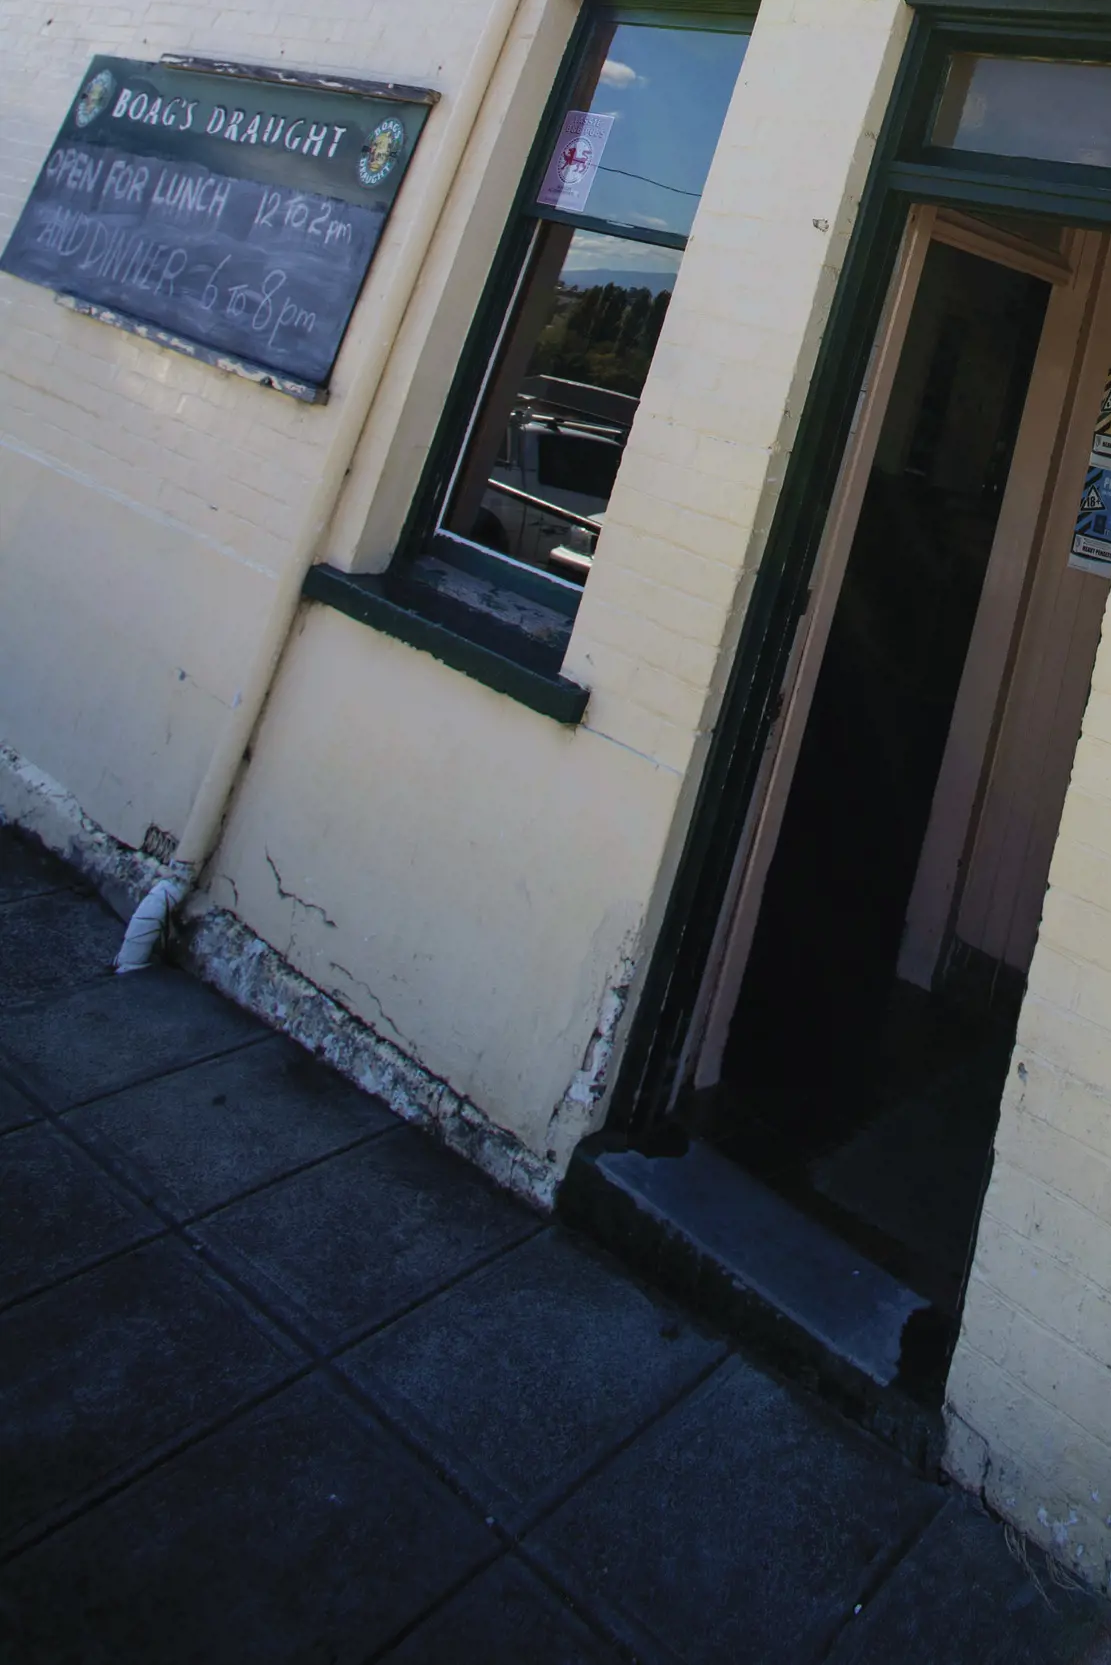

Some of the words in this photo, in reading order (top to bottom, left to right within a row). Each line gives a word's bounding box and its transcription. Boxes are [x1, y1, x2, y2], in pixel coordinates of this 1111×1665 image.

[112, 87, 198, 131] BOAG'S
[207, 106, 347, 159] DRAUGHT
[46, 148, 103, 193] OPEN
[102, 160, 149, 202] FOR
[152, 168, 231, 217] LUNCH
[255, 190, 281, 228] 12
[37, 205, 90, 256] AND
[79, 218, 188, 298] DINNER
[202, 254, 232, 311] 6
